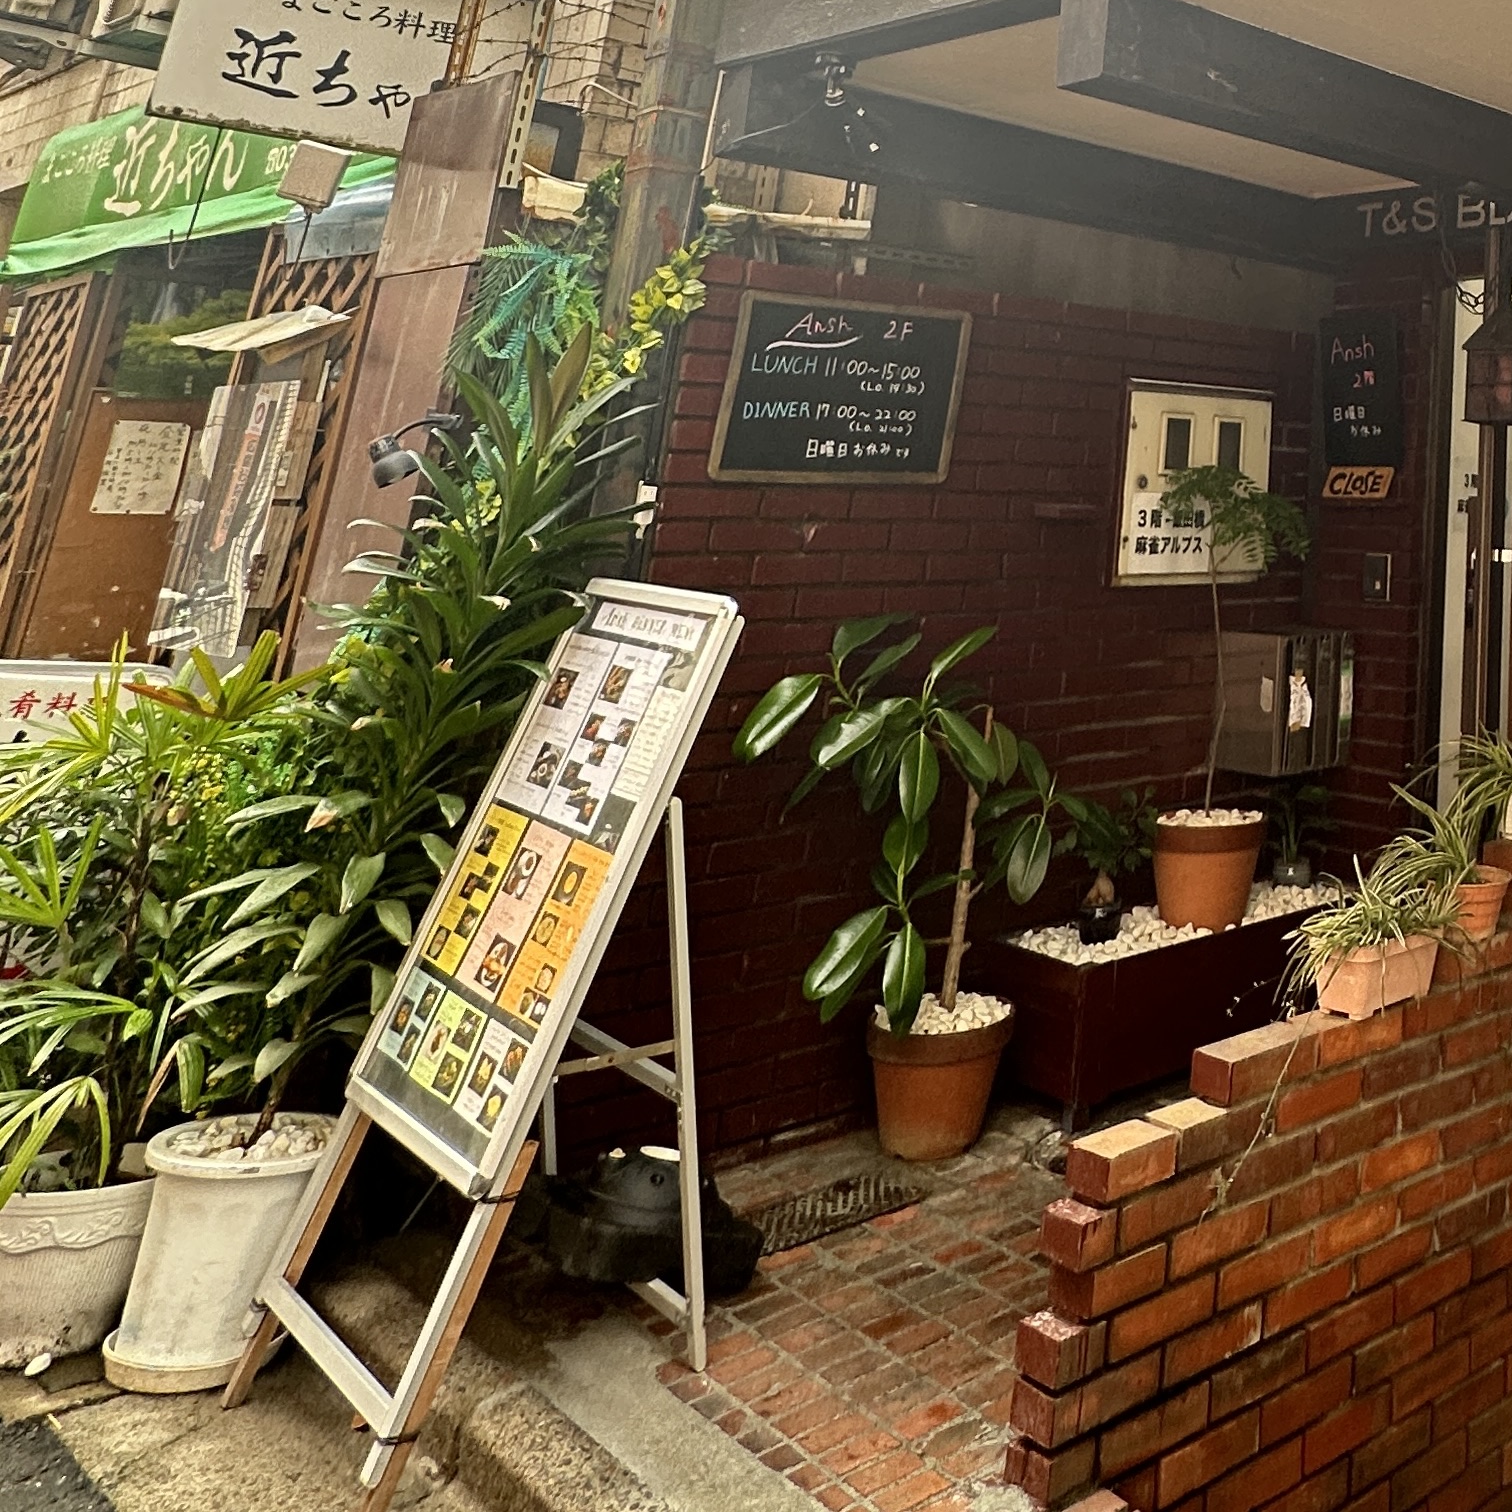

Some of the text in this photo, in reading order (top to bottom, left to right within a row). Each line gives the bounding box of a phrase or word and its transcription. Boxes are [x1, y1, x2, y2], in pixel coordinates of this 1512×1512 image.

[103, 117, 250, 217] 近ちゃん
[1357, 195, 1437, 238] T&S
[785, 312, 914, 342] Ansh 2F
[1330, 334, 1375, 365] Ansh
[751, 353, 819, 376] LUNCH
[743, 401, 811, 420] DINNER
[1329, 470, 1385, 496] CLOSE
[1134, 535, 1203, 555] 麻雀アルプス
